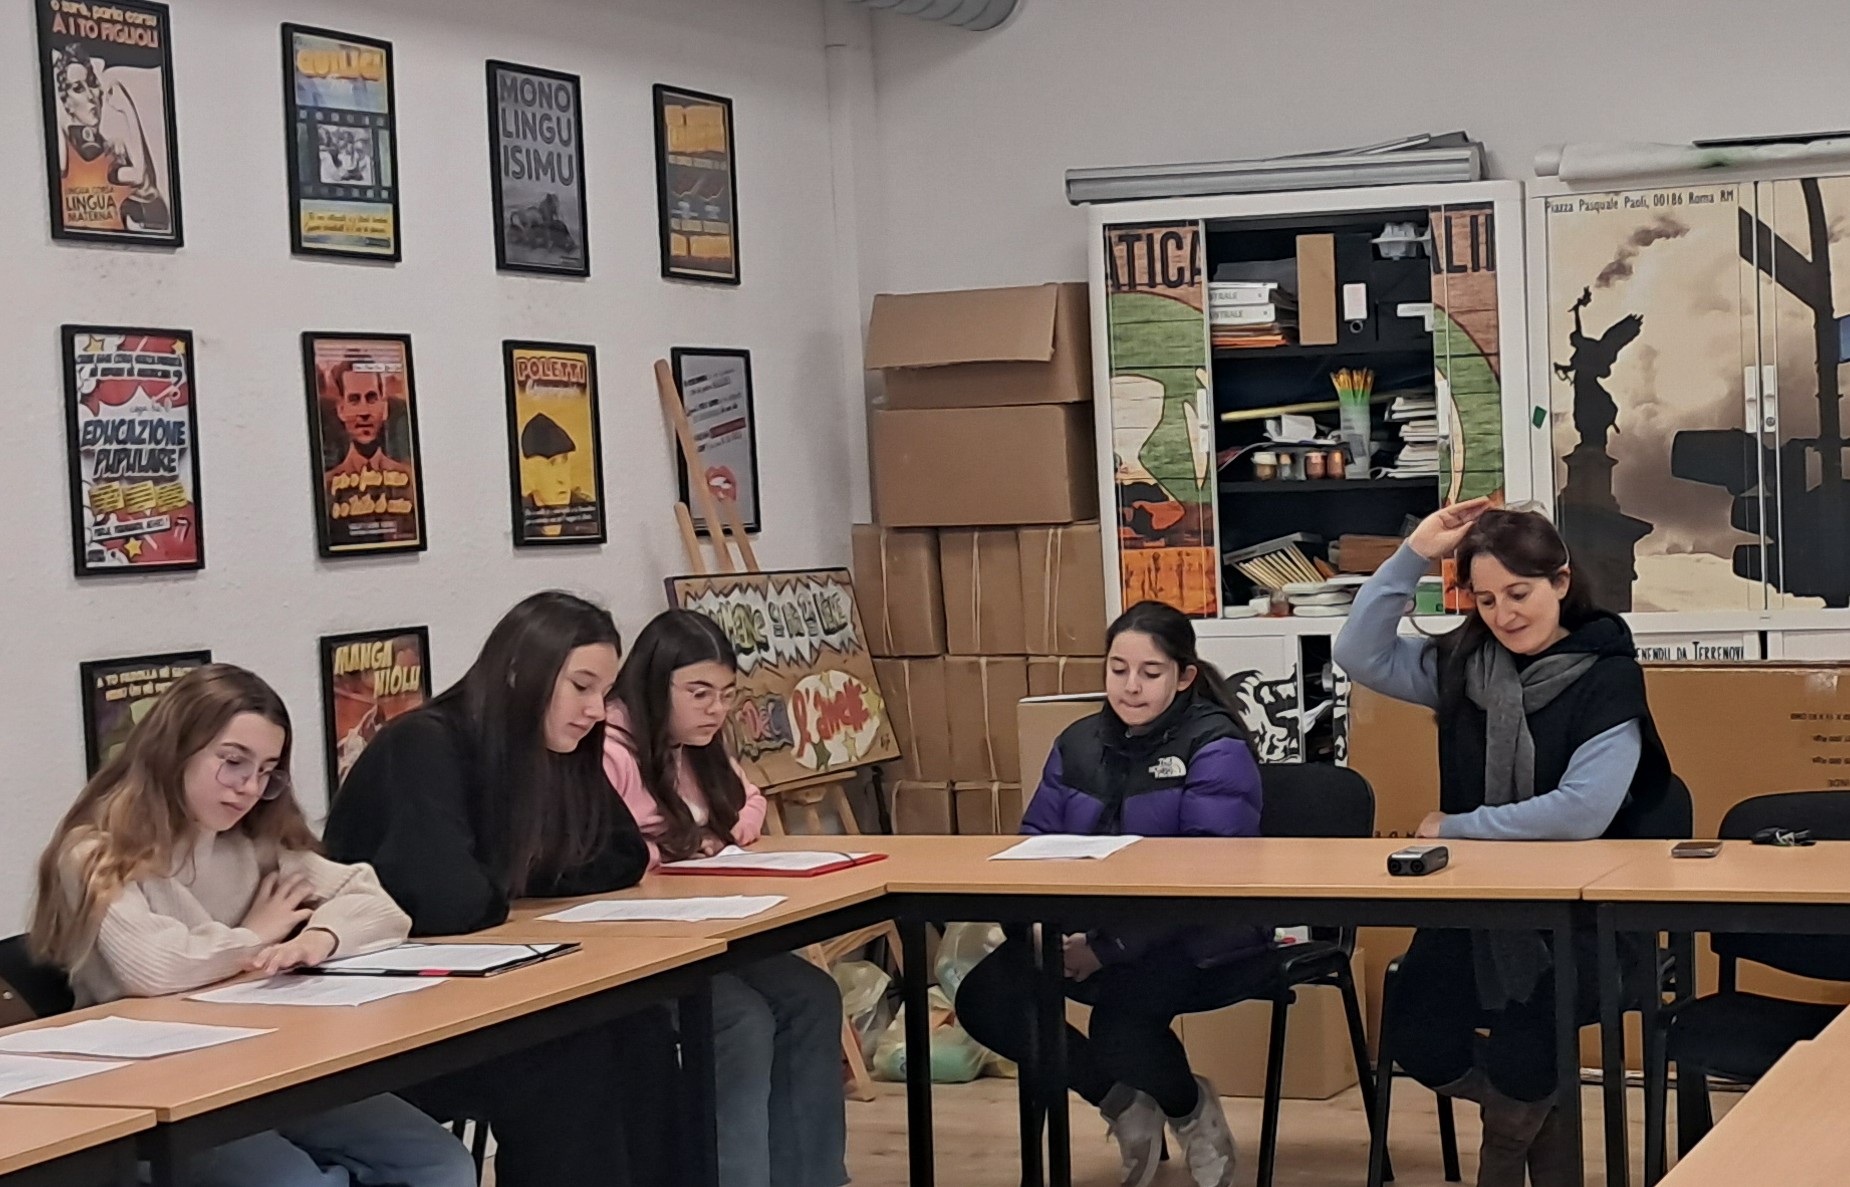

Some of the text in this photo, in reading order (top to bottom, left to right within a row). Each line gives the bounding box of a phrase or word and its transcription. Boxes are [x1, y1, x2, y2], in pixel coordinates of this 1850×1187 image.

[77, 18, 99, 39] TO
[101, 21, 159, 48] FIGLIOLI
[500, 75, 571, 113] MONO
[501, 107, 572, 148] LINGU
[503, 144, 574, 187] ISIMU
[65, 194, 118, 211] LINGUA
[1579, 198, 1619, 213] Pasquale
[1624, 195, 1650, 209] Paoli,
[1653, 193, 1683, 206] 00186
[1688, 192, 1715, 204] Roma
[1720, 189, 1734, 202] RM
[517, 358, 586, 384] POLETTI
[82, 418, 186, 447] EDUCAZIONE
[93, 448, 178, 476] PUPULARE
[334, 640, 393, 676] MANGA
[373, 664, 421, 699] NIOLU
